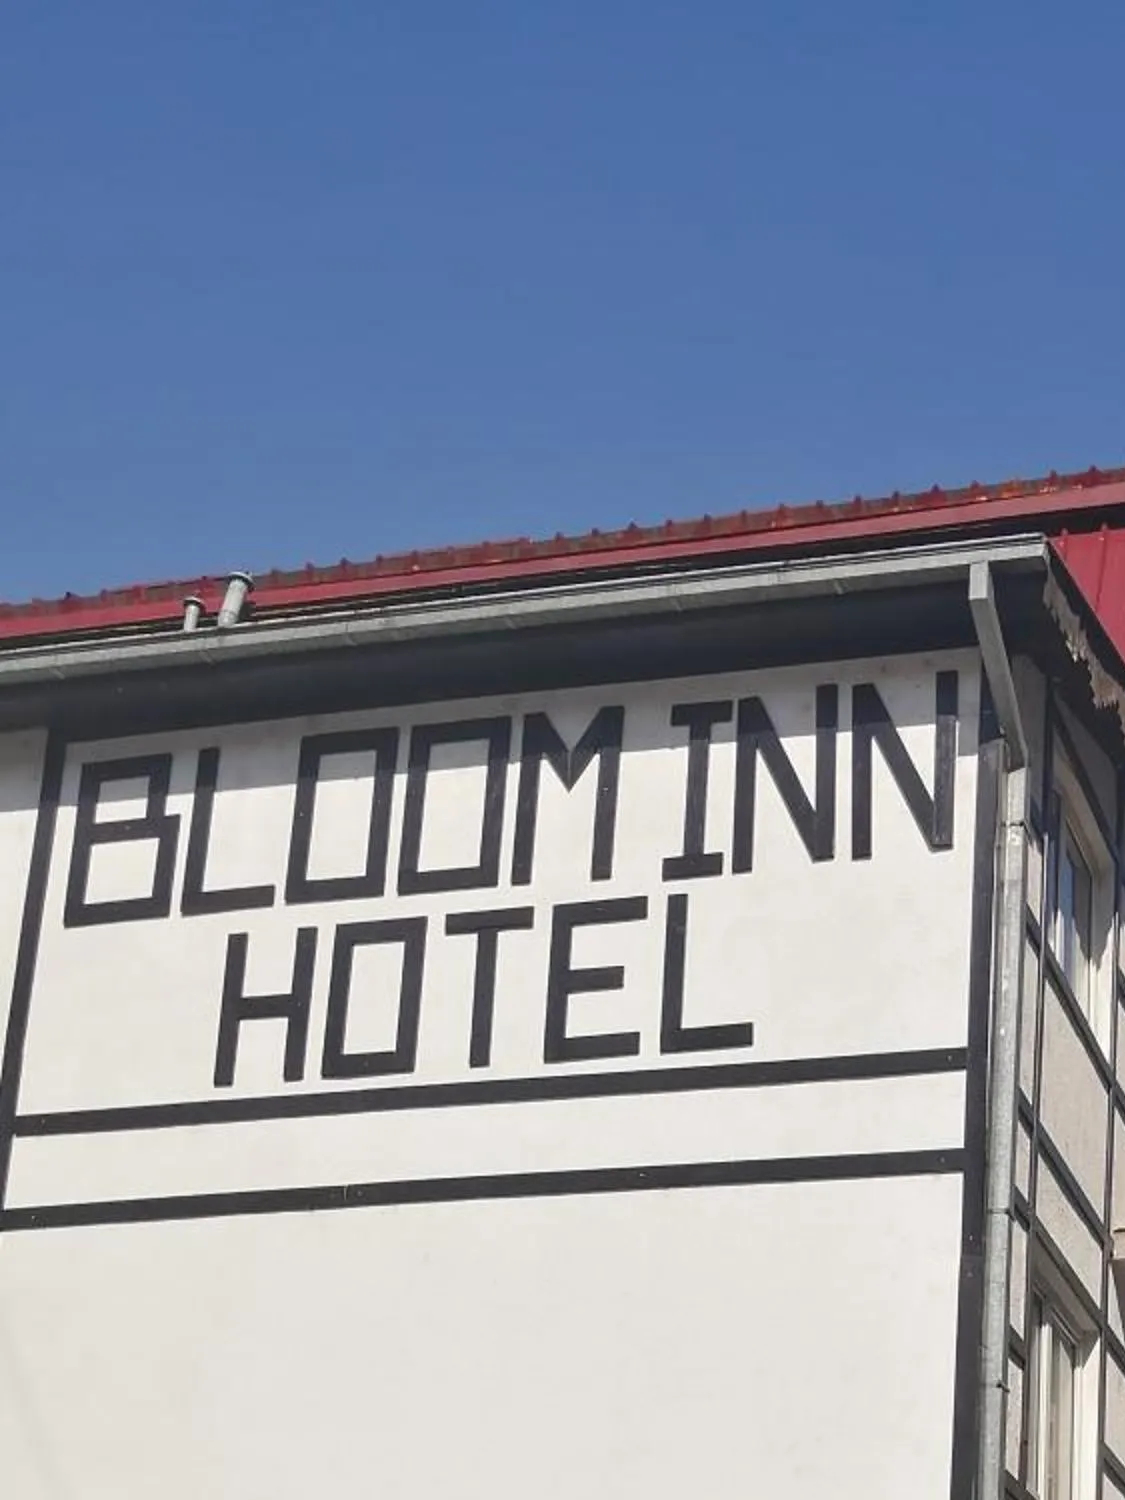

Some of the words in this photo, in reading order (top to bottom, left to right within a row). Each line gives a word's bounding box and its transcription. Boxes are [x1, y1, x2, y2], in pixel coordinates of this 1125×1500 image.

[63, 704, 625, 928] BLOOM
[661, 670, 959, 881] INN
[213, 893, 754, 1088] HOTEL
